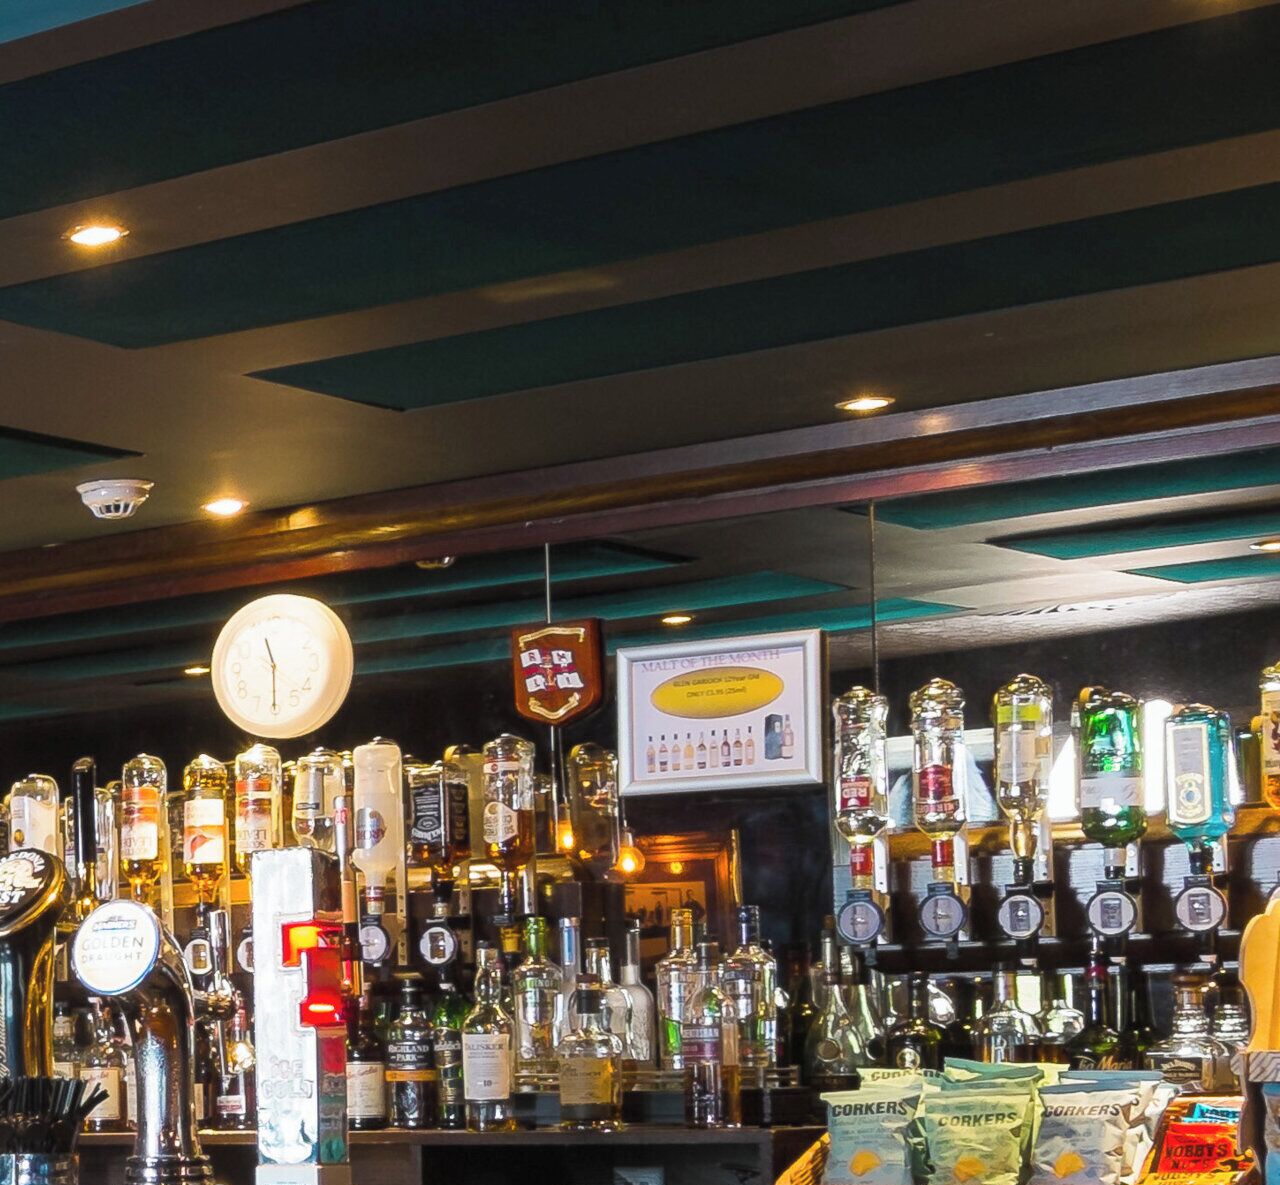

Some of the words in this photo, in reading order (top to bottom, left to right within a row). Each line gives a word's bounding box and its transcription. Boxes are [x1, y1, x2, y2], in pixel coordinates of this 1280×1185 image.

[641, 660, 676, 673] MALT
[680, 658, 695, 669] OF
[701, 655, 726, 666] THE
[729, 650, 781, 663] MONTH
[82, 937, 144, 951] GOLDEN
[396, 1054, 418, 1062] PARK
[832, 1101, 907, 1117] CORKERS
[1045, 1103, 1120, 1118] CORKERS
[938, 1112, 1017, 1127] CORKERS
